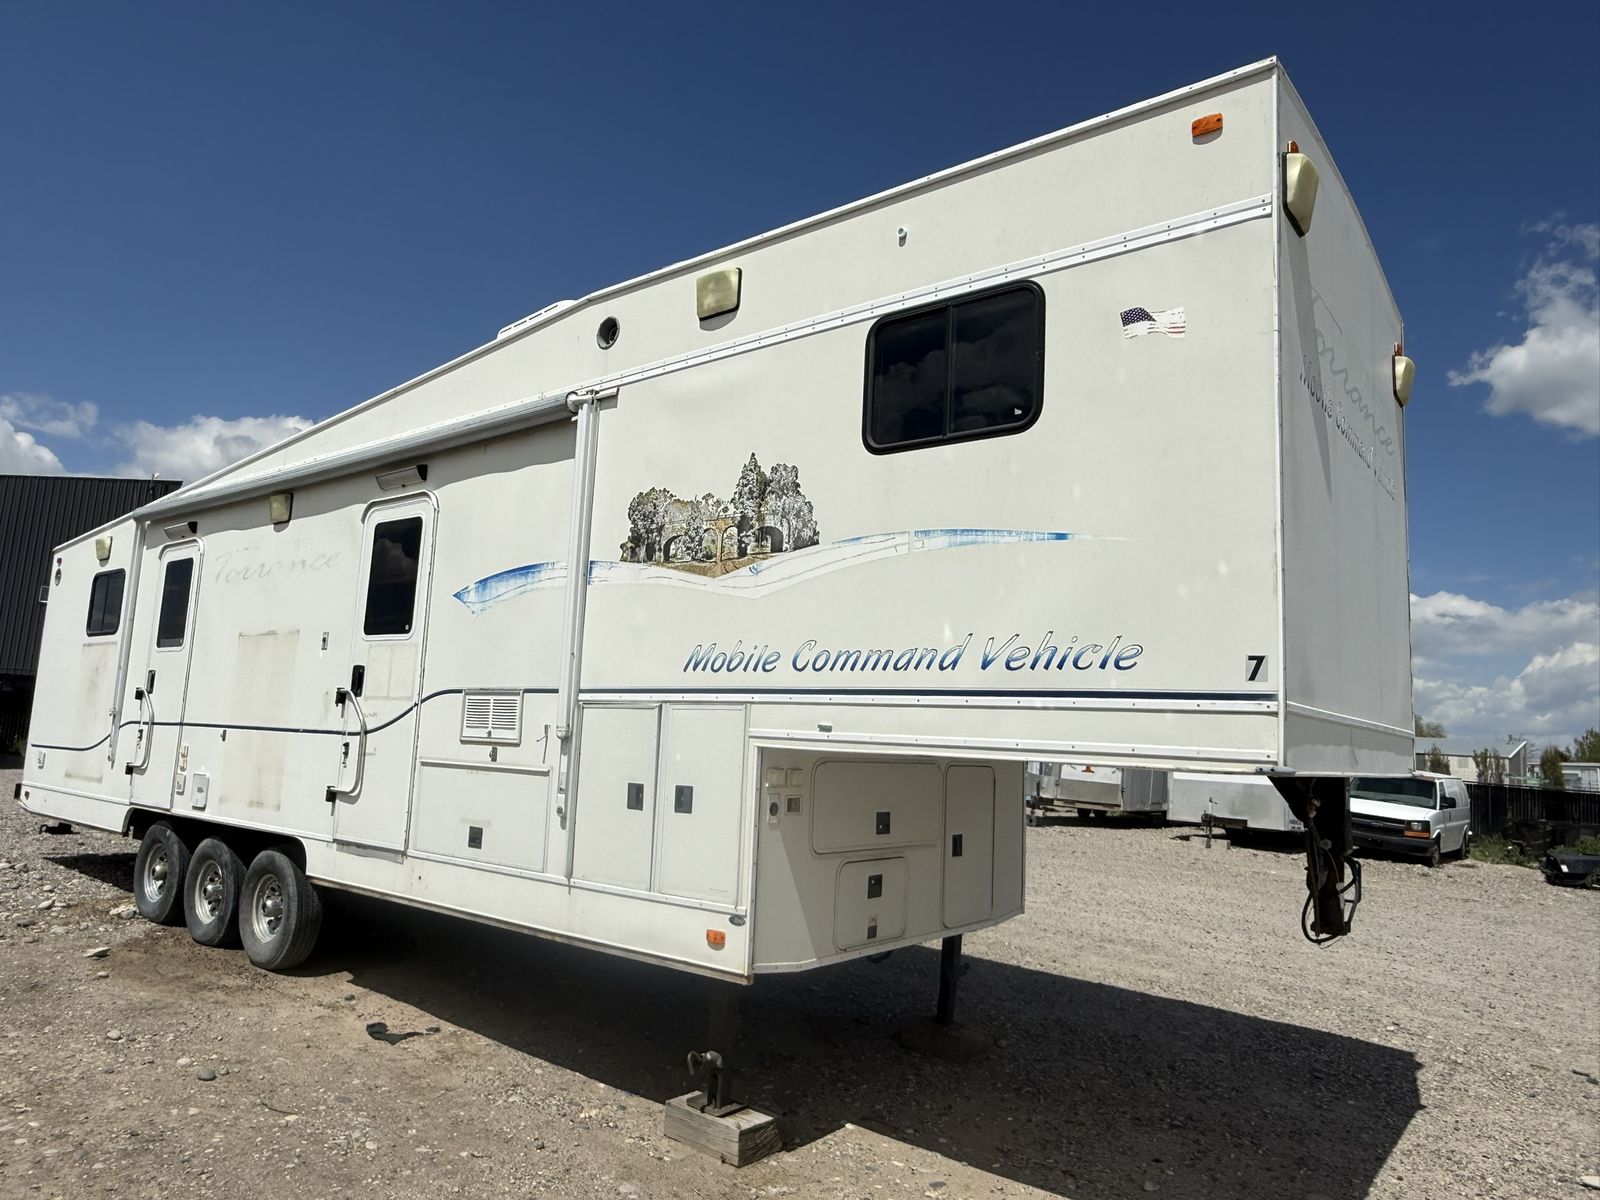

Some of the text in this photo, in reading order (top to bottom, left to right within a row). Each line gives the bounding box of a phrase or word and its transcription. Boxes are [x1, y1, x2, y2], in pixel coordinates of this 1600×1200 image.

[683, 630, 1144, 674] Mobile Command Vehicle
[1247, 655, 1266, 682] 7
